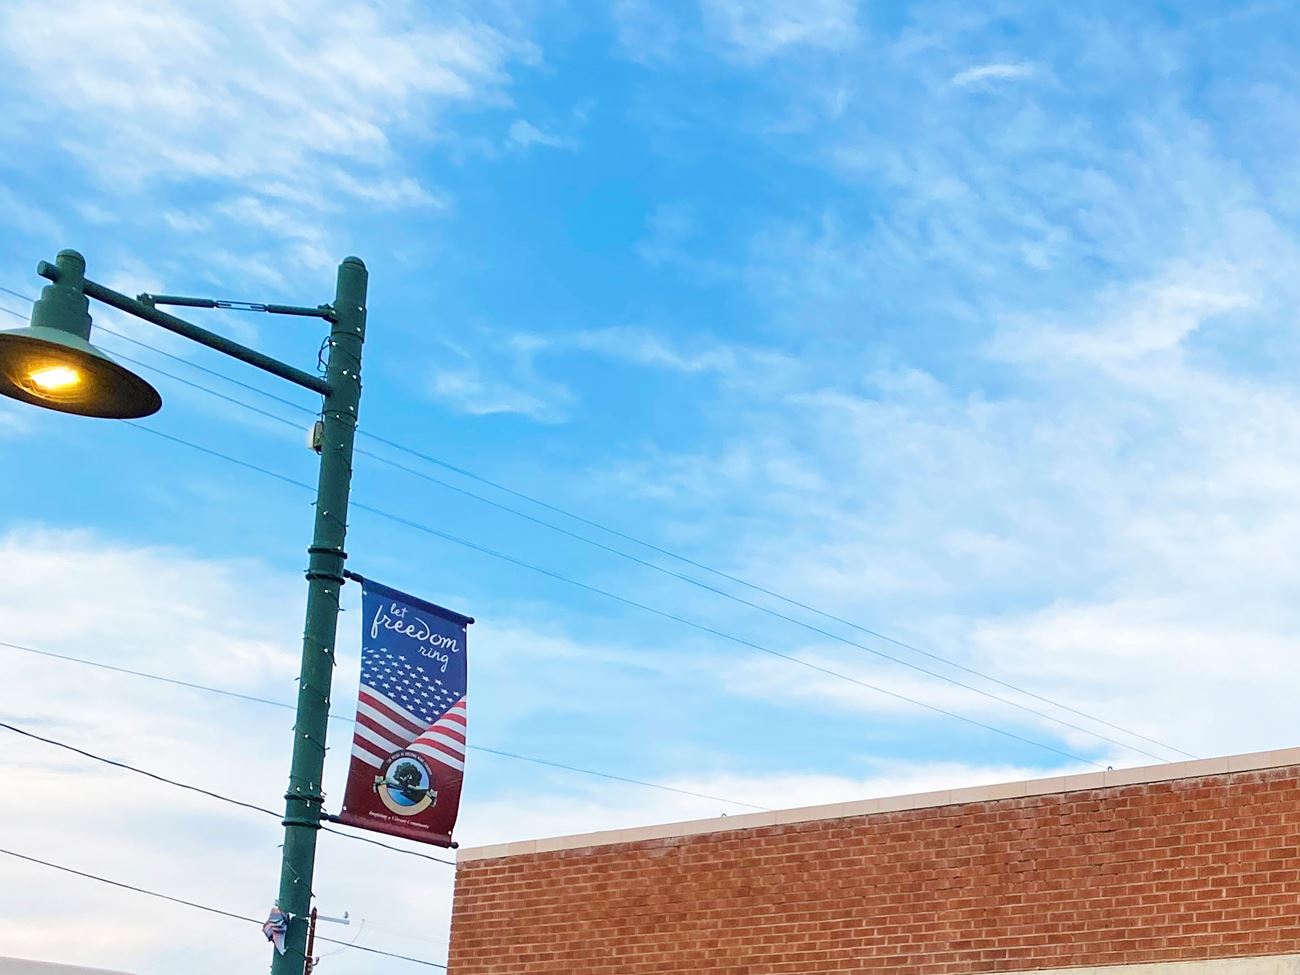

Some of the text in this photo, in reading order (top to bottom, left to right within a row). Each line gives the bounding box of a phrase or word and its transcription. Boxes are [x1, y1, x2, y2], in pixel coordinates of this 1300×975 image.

[390, 602, 408, 618] let
[371, 604, 461, 653] freedom
[417, 645, 449, 673] ring
